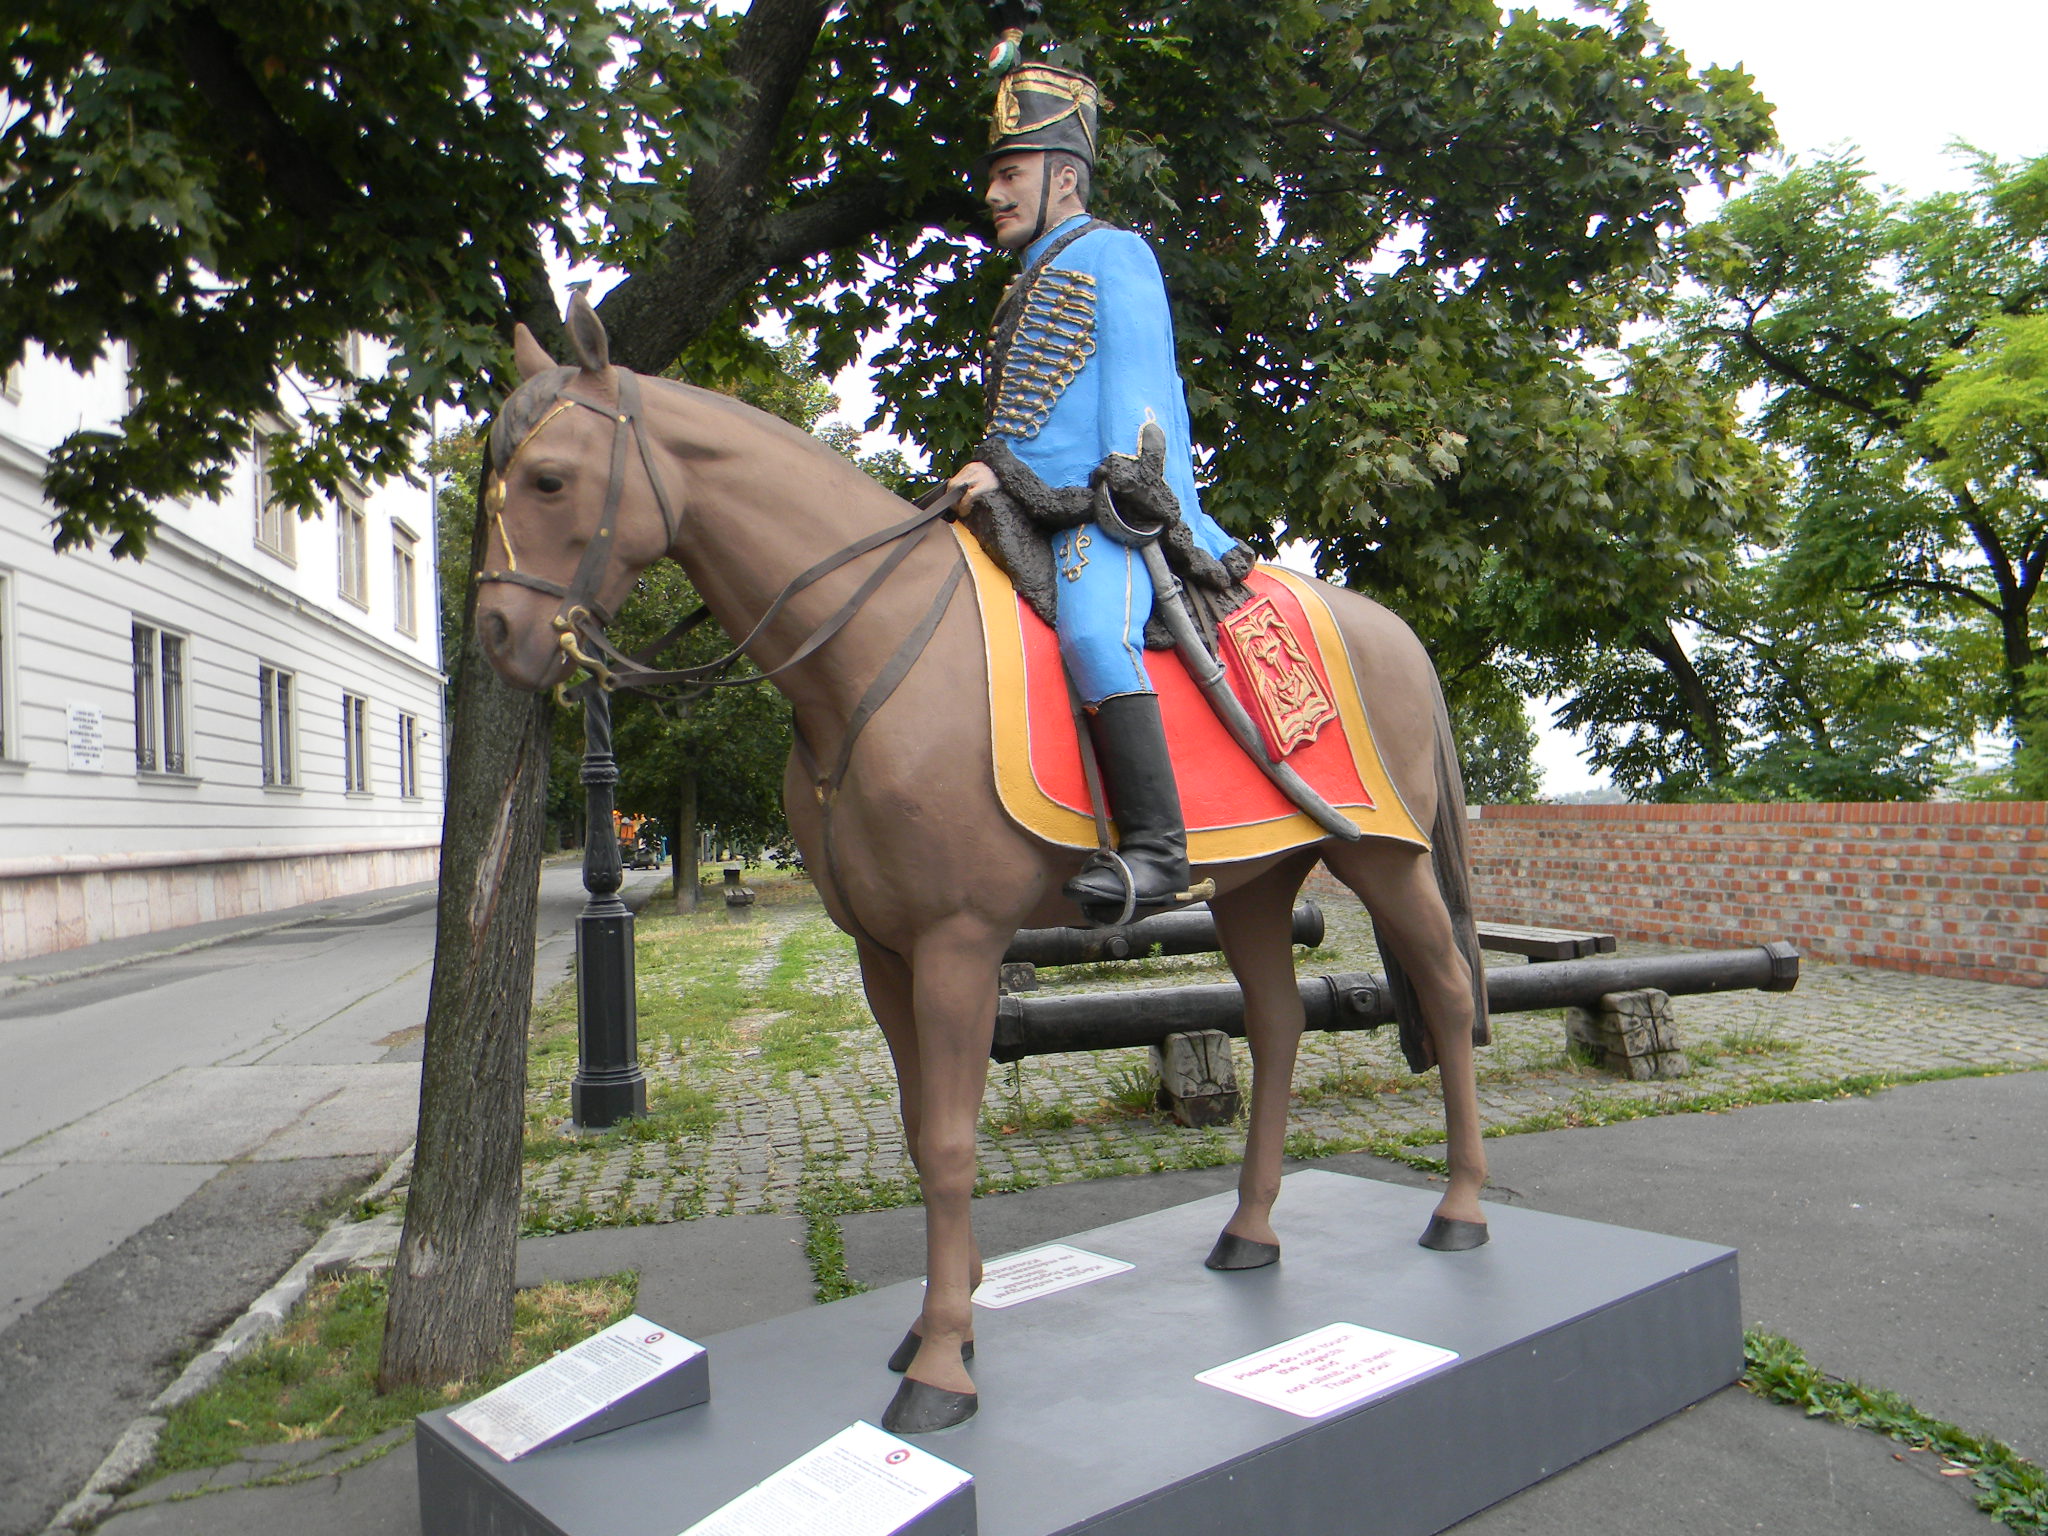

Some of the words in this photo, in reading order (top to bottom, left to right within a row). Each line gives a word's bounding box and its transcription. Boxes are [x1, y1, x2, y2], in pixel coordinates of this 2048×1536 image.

[1233, 1363, 1279, 1380] Please
[1279, 1355, 1298, 1364] do
[1298, 1347, 1318, 1357] not
[1317, 1335, 1353, 1349] touch
[1276, 1365, 1301, 1375] the
[1300, 1348, 1346, 1367] objects
[1315, 1360, 1340, 1372] and
[1285, 1383, 1308, 1394] not
[1308, 1370, 1345, 1385] climb
[1321, 1372, 1363, 1390] Thank
